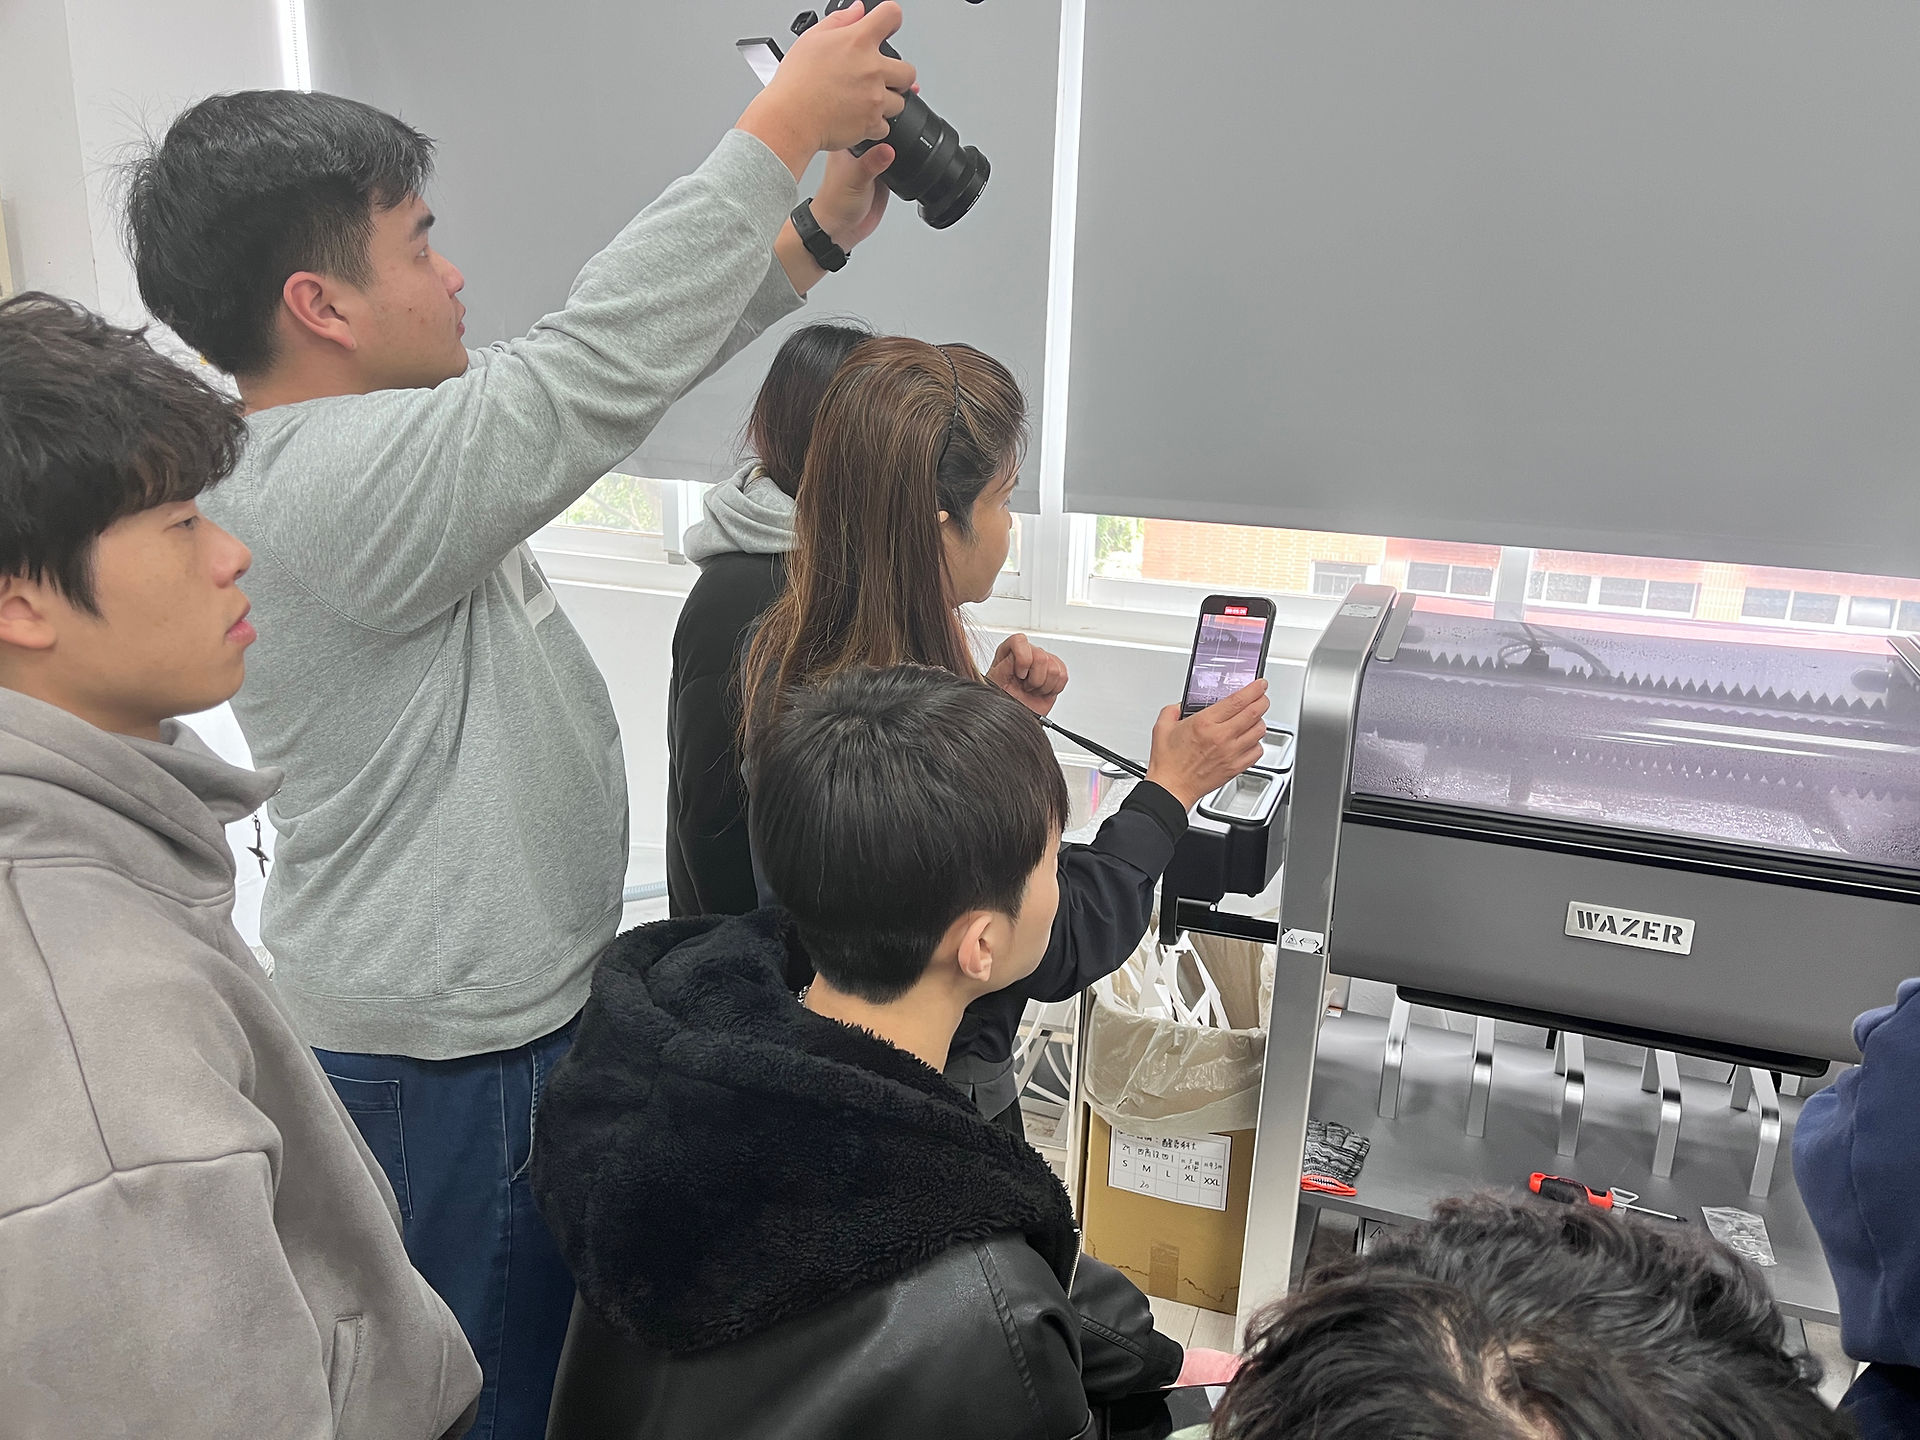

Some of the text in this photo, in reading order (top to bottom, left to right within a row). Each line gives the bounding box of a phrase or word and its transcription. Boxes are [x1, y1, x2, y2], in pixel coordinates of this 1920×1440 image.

[1576, 909, 1683, 946] WAZER
[1122, 1159, 1221, 1187] S M L XL XXL
